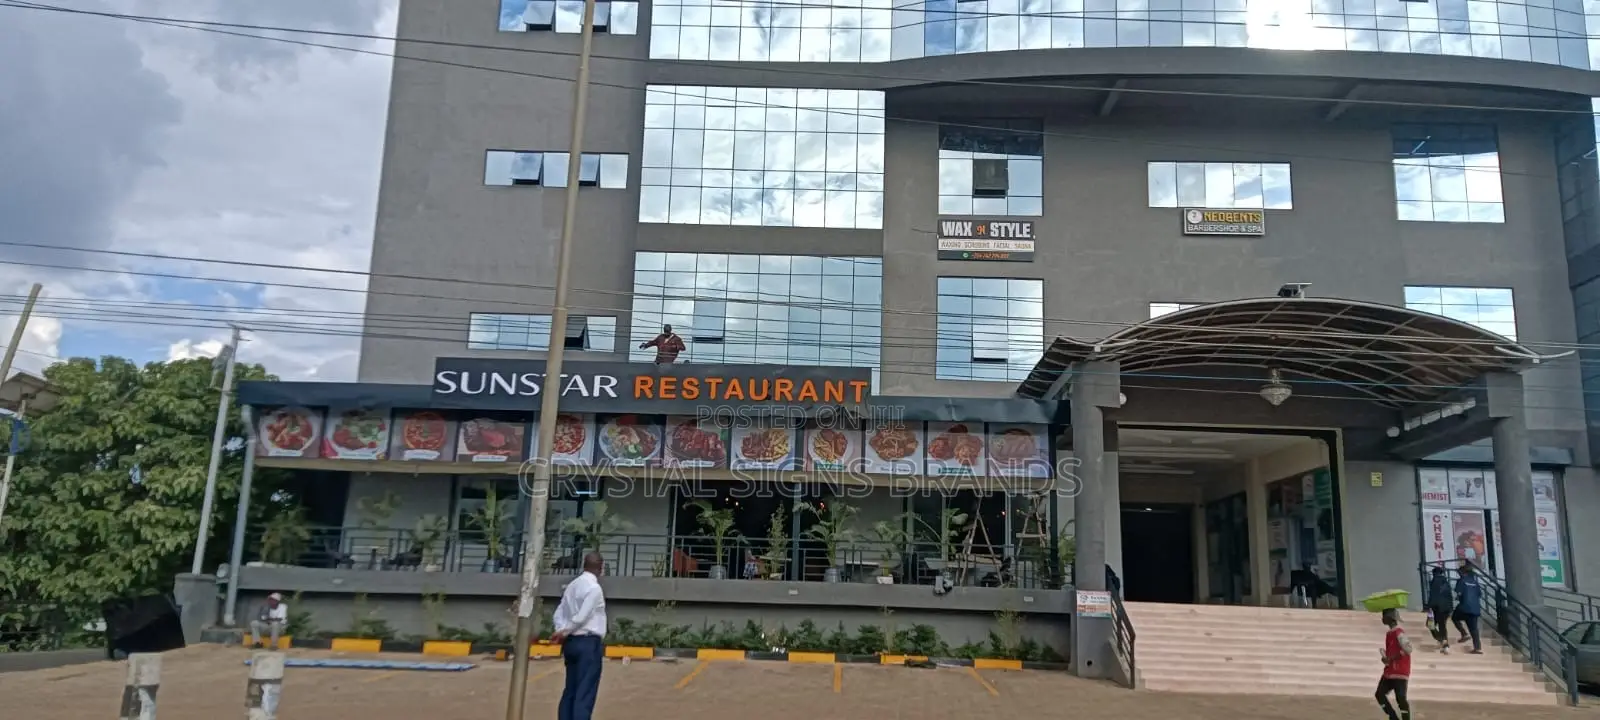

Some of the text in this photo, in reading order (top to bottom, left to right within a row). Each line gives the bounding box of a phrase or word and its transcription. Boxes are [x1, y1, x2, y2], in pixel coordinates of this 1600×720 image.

[941, 221, 972, 237] WAX
[990, 222, 1031, 238] STYLE
[1187, 224, 1239, 232] BARBERSHOP
[1247, 225, 1262, 233] SPA
[633, 375, 868, 403] RESTAURANT
